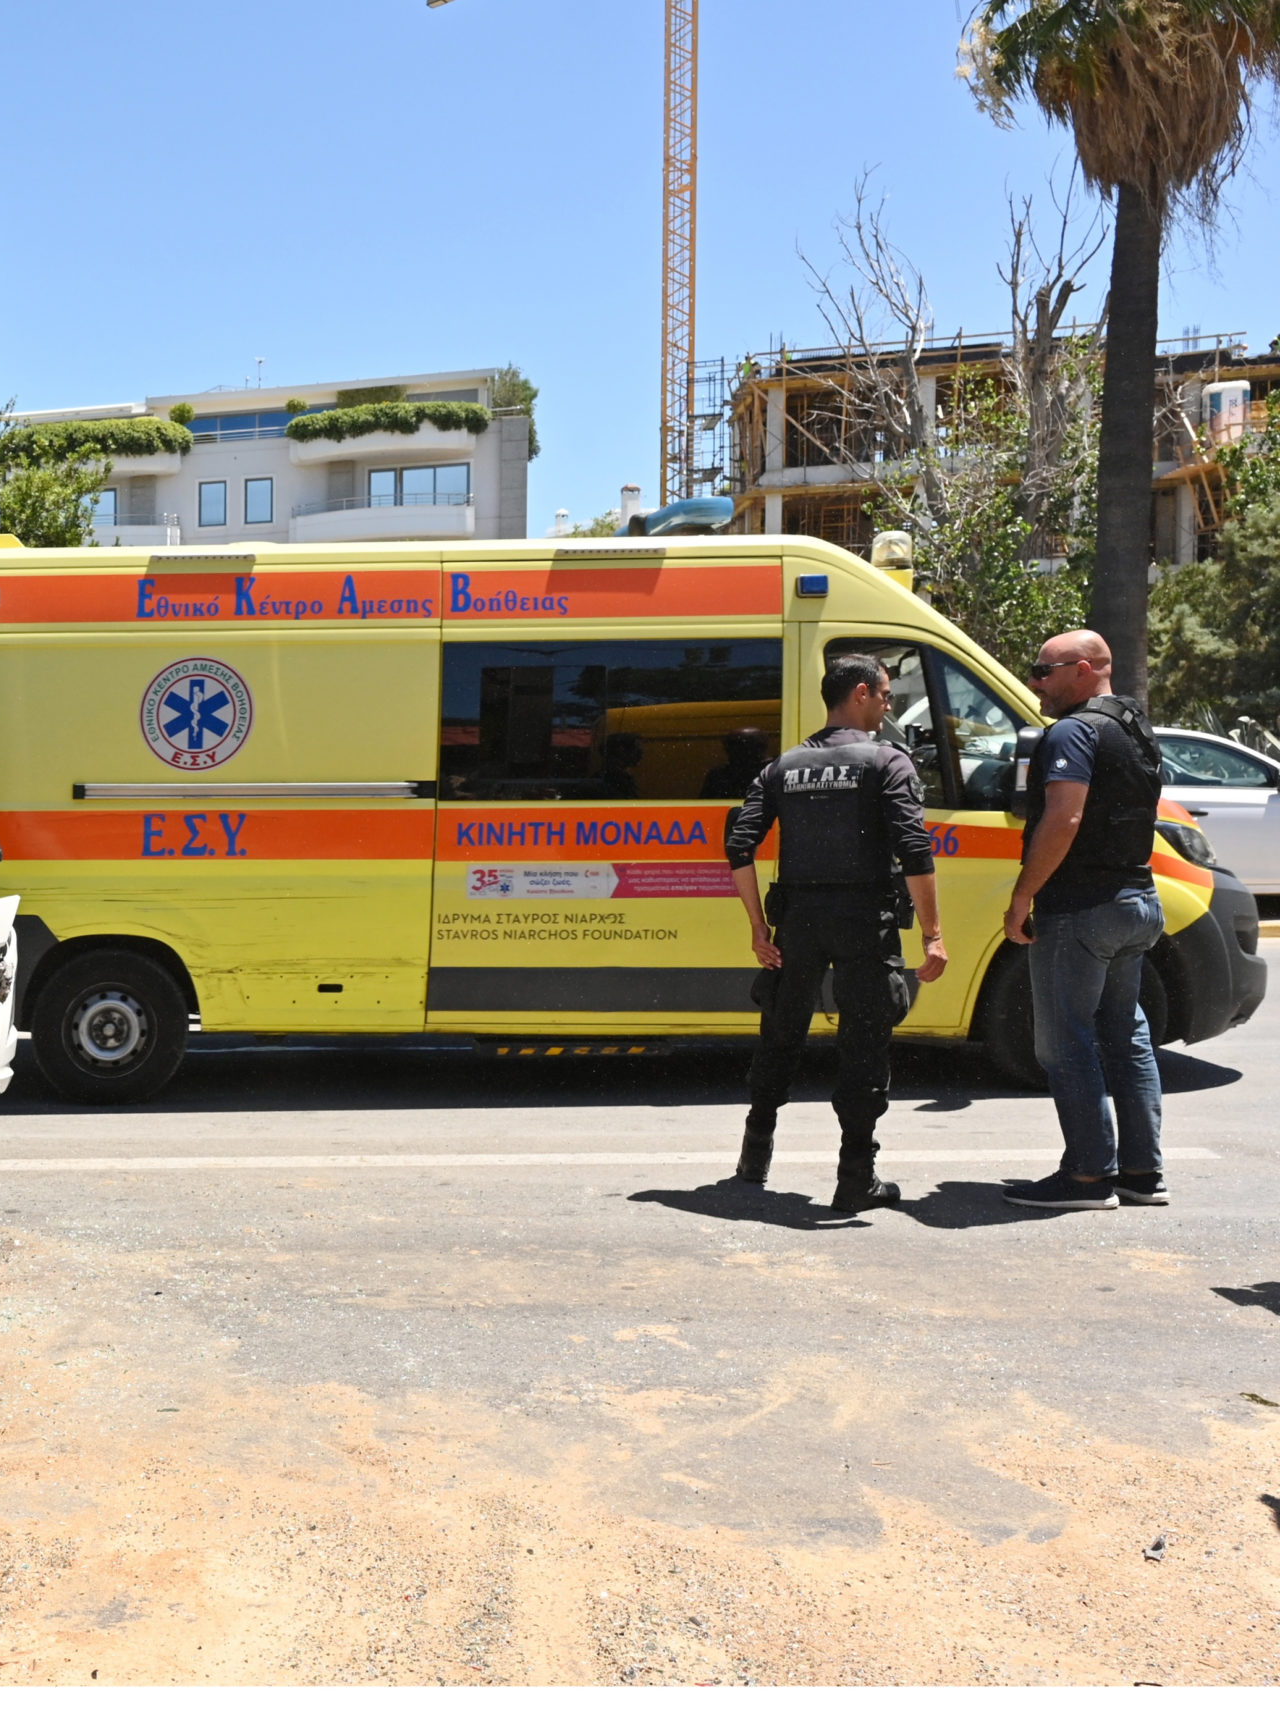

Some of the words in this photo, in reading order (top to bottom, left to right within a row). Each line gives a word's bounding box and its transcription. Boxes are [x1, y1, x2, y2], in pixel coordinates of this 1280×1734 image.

[136, 578, 220, 618] Εθνικό
[233, 576, 323, 620] Κέντρο
[450, 572, 568, 615] Βοήθειας
[152, 664, 190, 696] ΚΕΝΤΡΟ
[192, 663, 234, 685] ΑΜΕΣΗΣ
[141, 813, 247, 857] Ε.Σ.Υ.
[456, 822, 565, 846] ΚΙΝΗΤΗ
[575, 820, 708, 845] ΜΟΝΑΔΑ
[437, 913, 492, 924] ΙΔΡΥΜΑ
[495, 913, 560, 924] ΣΤΑΥΡΟΣ
[437, 929, 499, 940] STAVROS
[503, 929, 578, 940] NIARCHOS
[582, 929, 678, 940] FOUNDATION
